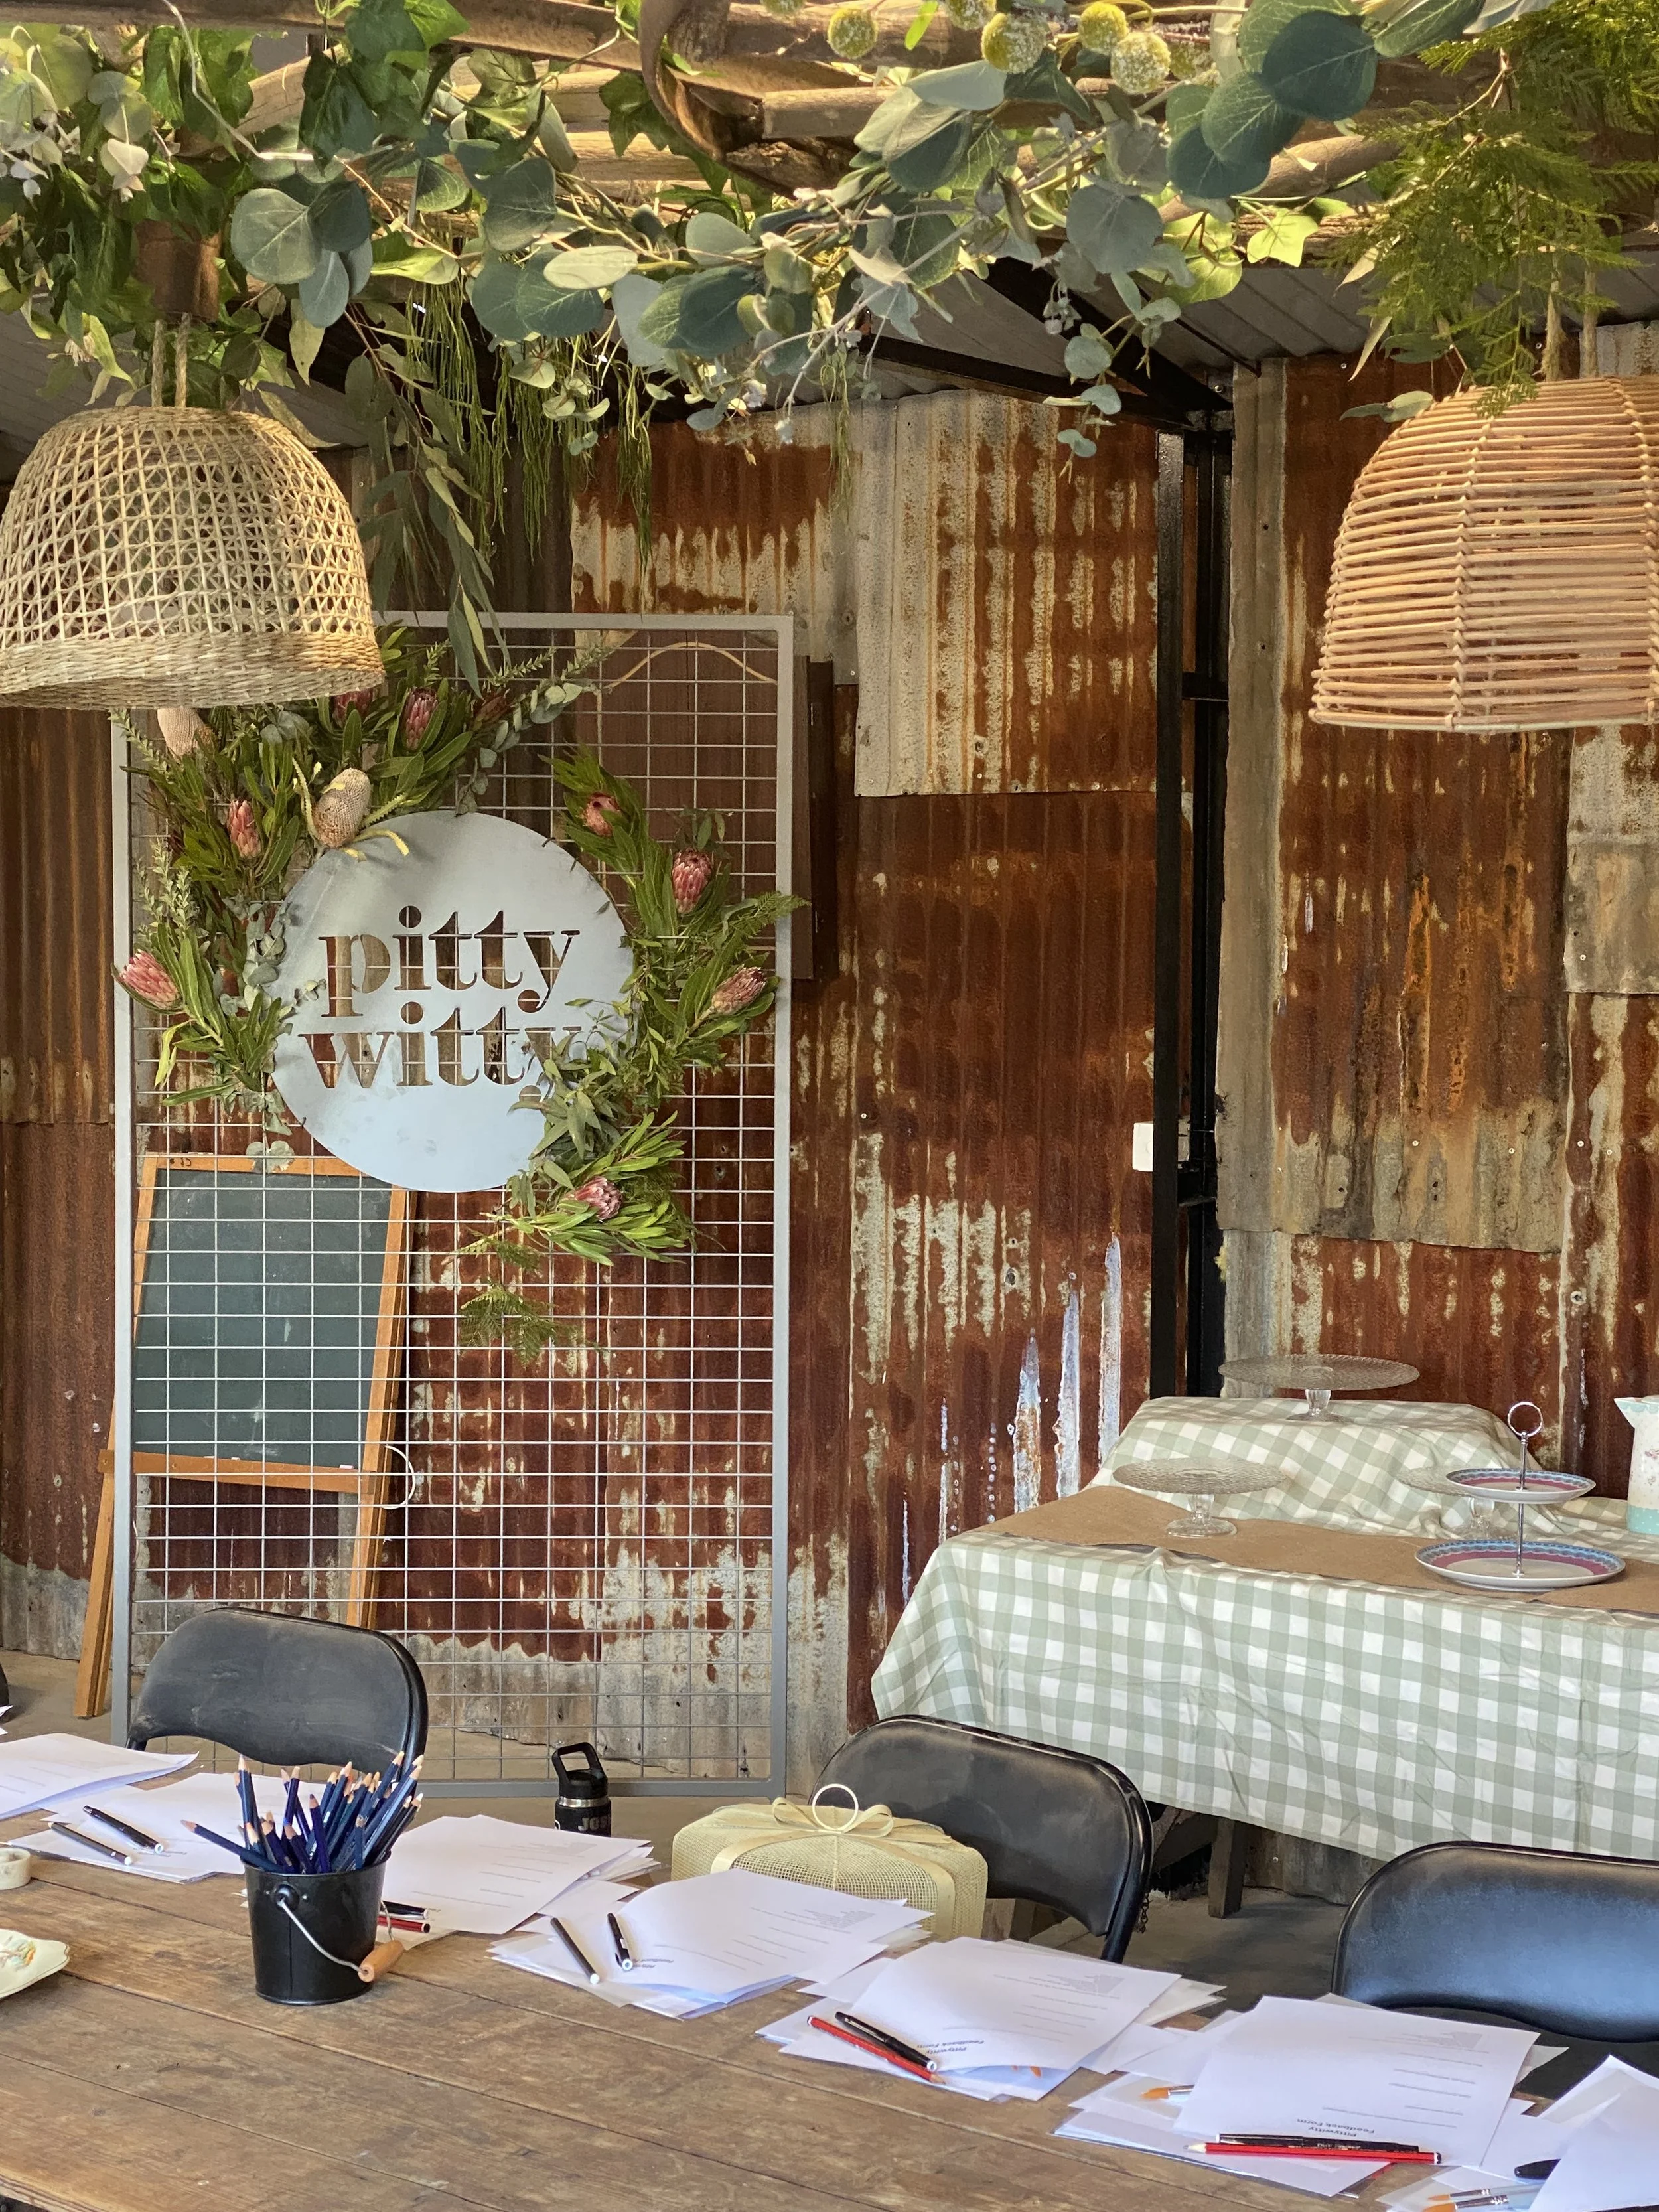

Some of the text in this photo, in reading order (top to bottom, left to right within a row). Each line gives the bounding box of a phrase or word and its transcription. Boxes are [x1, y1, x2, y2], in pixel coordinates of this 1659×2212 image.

[318, 905, 581, 1017] pitty
[297, 1001, 582, 1102] witty
[1297, 2118, 1323, 2127] Form
[1325, 2122, 1375, 2134] Feedback
[1307, 2126, 1357, 2138] Pittywitty
